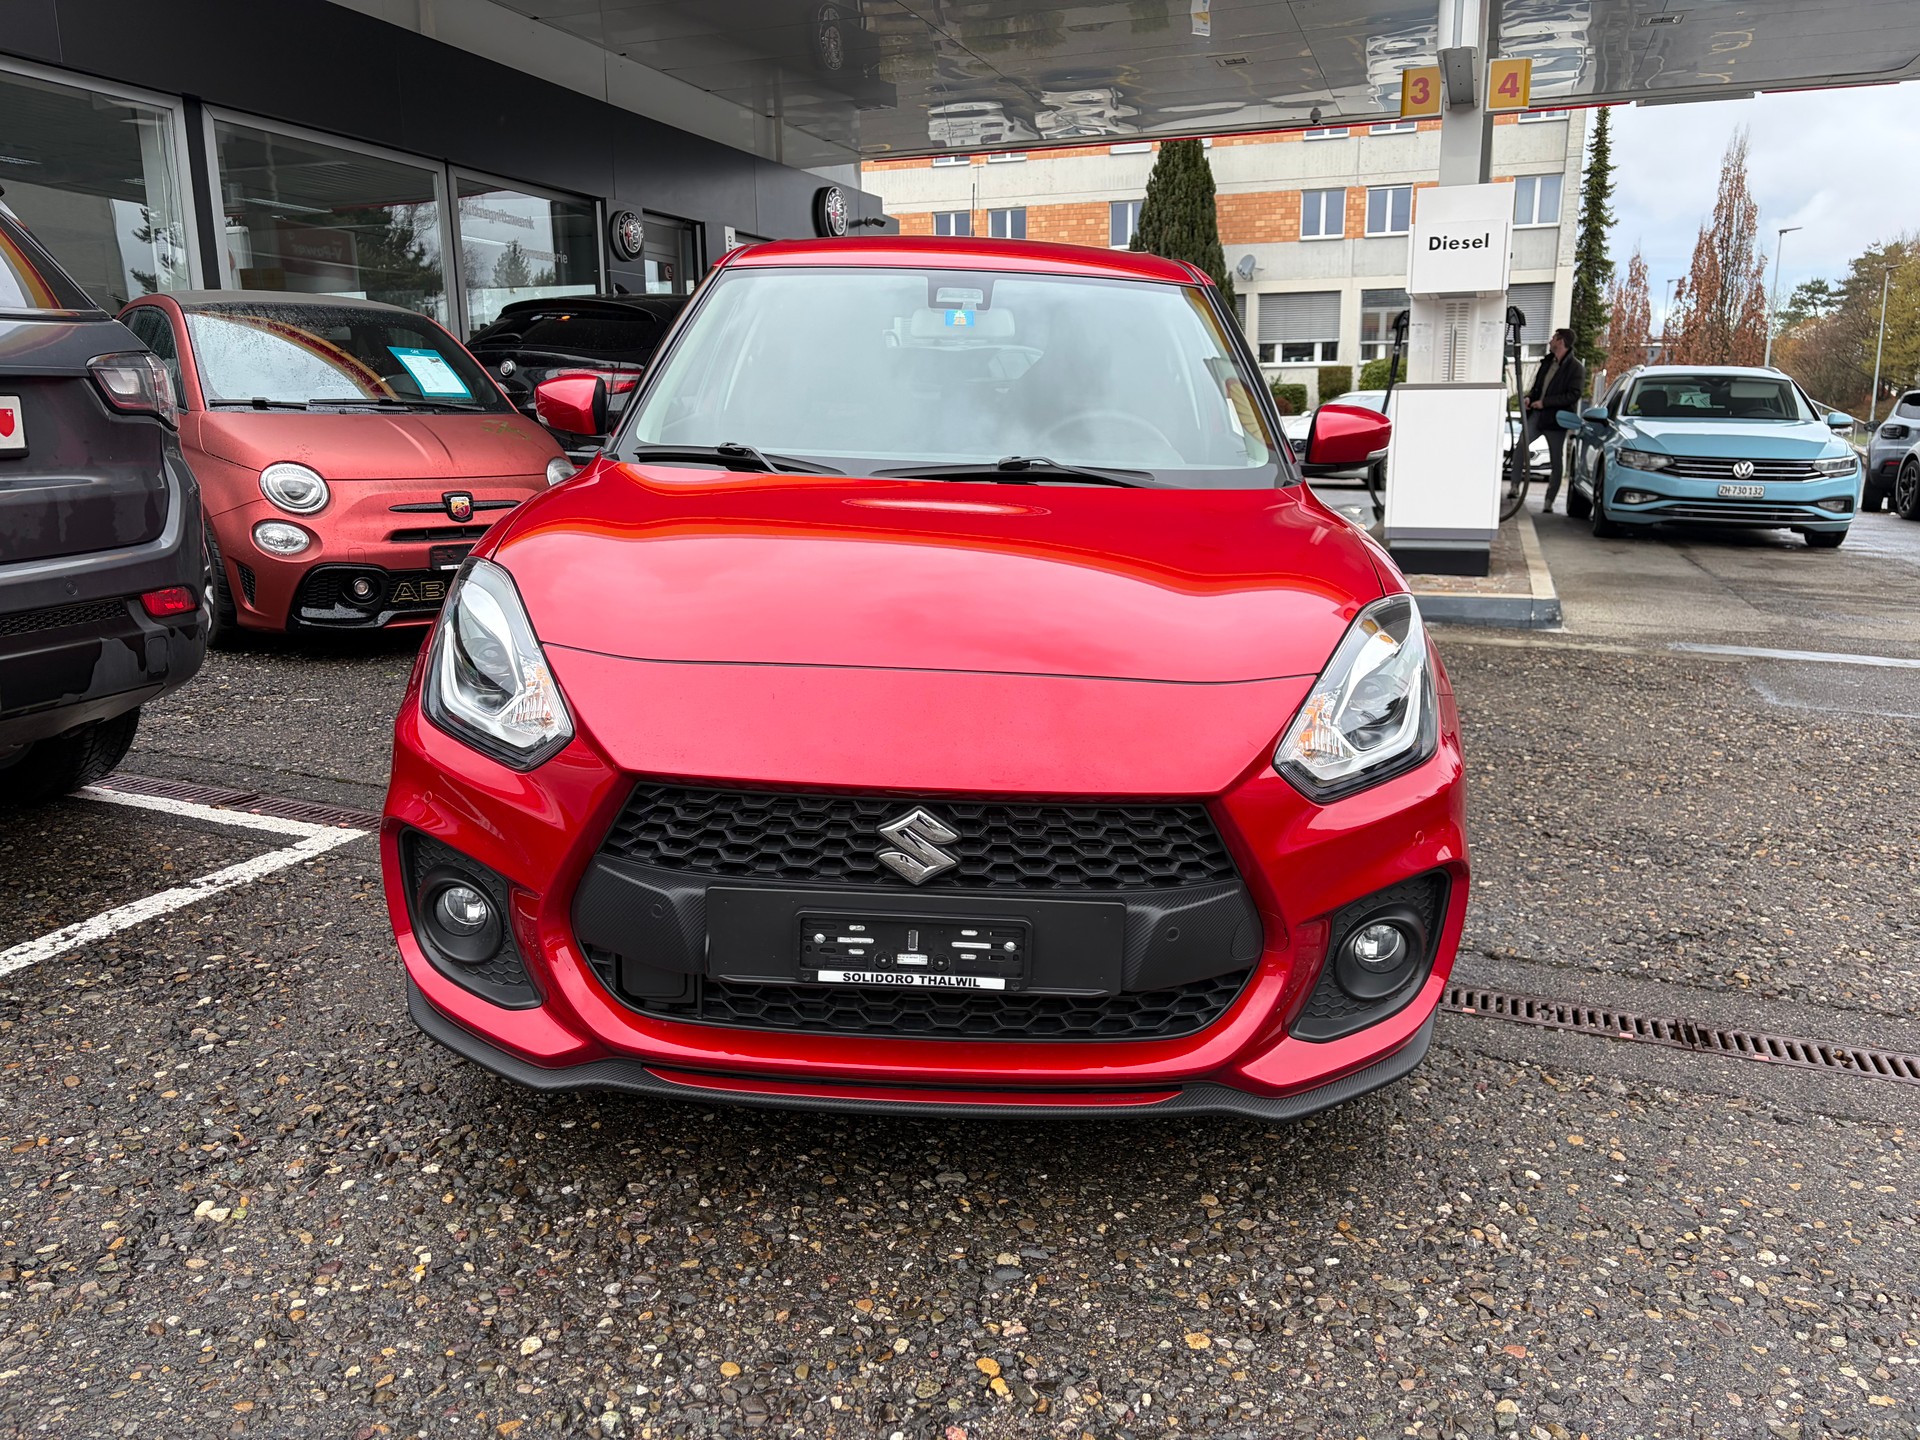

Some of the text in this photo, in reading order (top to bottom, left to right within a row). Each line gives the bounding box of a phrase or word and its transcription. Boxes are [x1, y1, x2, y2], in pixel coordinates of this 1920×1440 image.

[1410, 77, 1430, 105] 3
[1498, 72, 1520, 98] 4
[1429, 233, 1490, 251] Diesel
[391, 581, 446, 602] AB
[843, 972, 981, 988] SOLIDORO THALWIL
